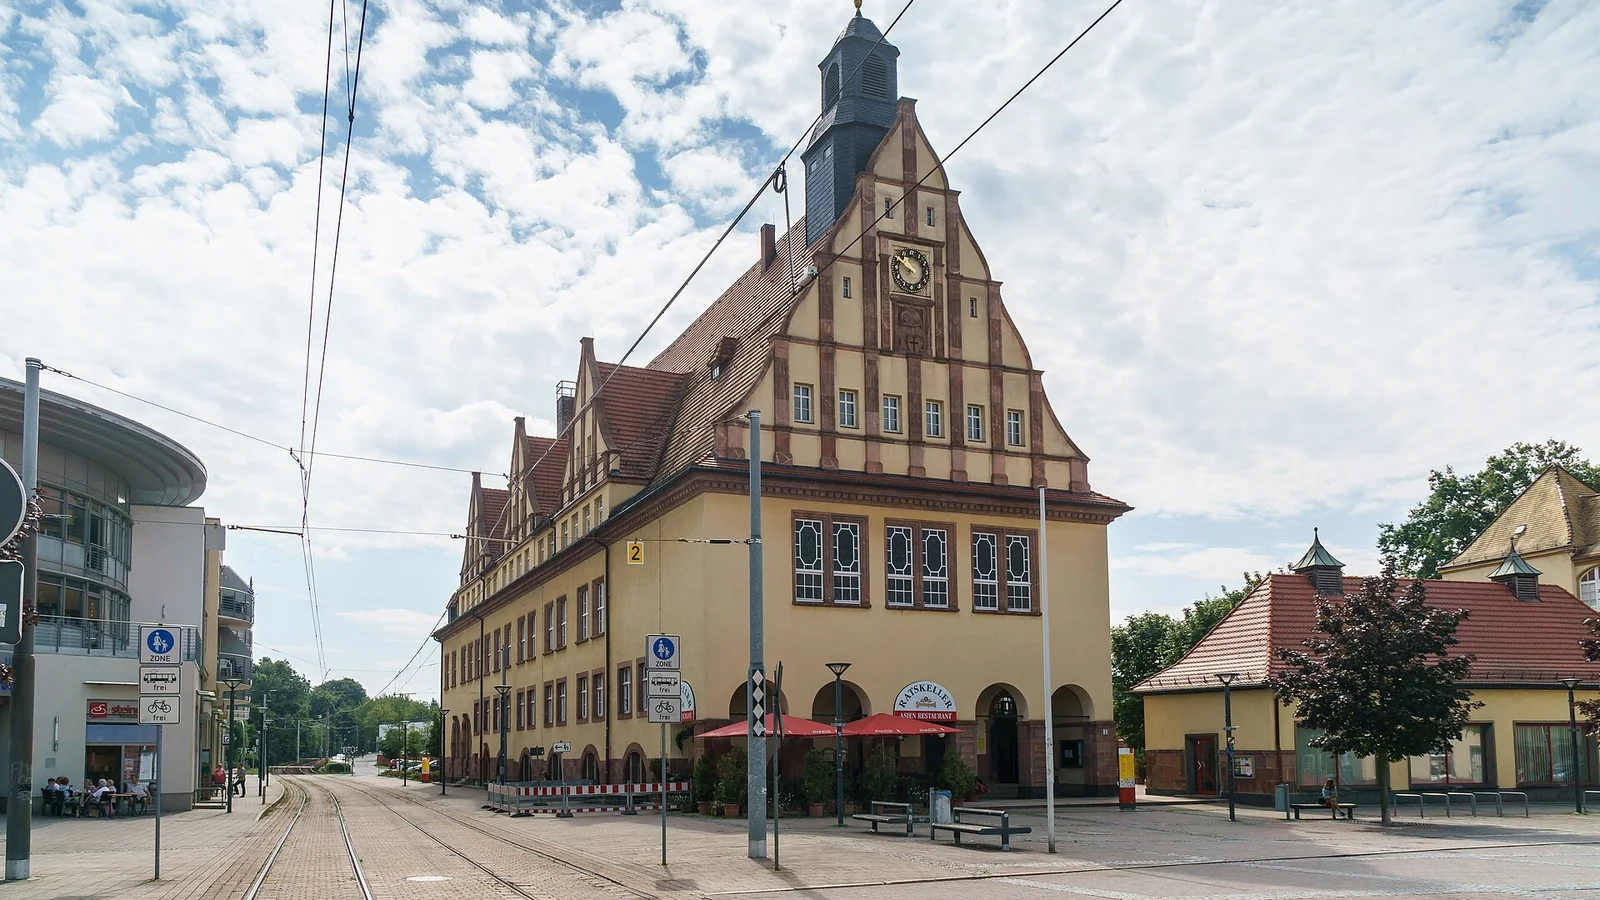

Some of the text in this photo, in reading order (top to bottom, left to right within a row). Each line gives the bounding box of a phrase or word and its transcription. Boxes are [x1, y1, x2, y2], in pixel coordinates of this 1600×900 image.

[631, 545, 640, 560] 2
[898, 683, 953, 709] RATSKELLER
[917, 712, 953, 720] RESTAURANT
